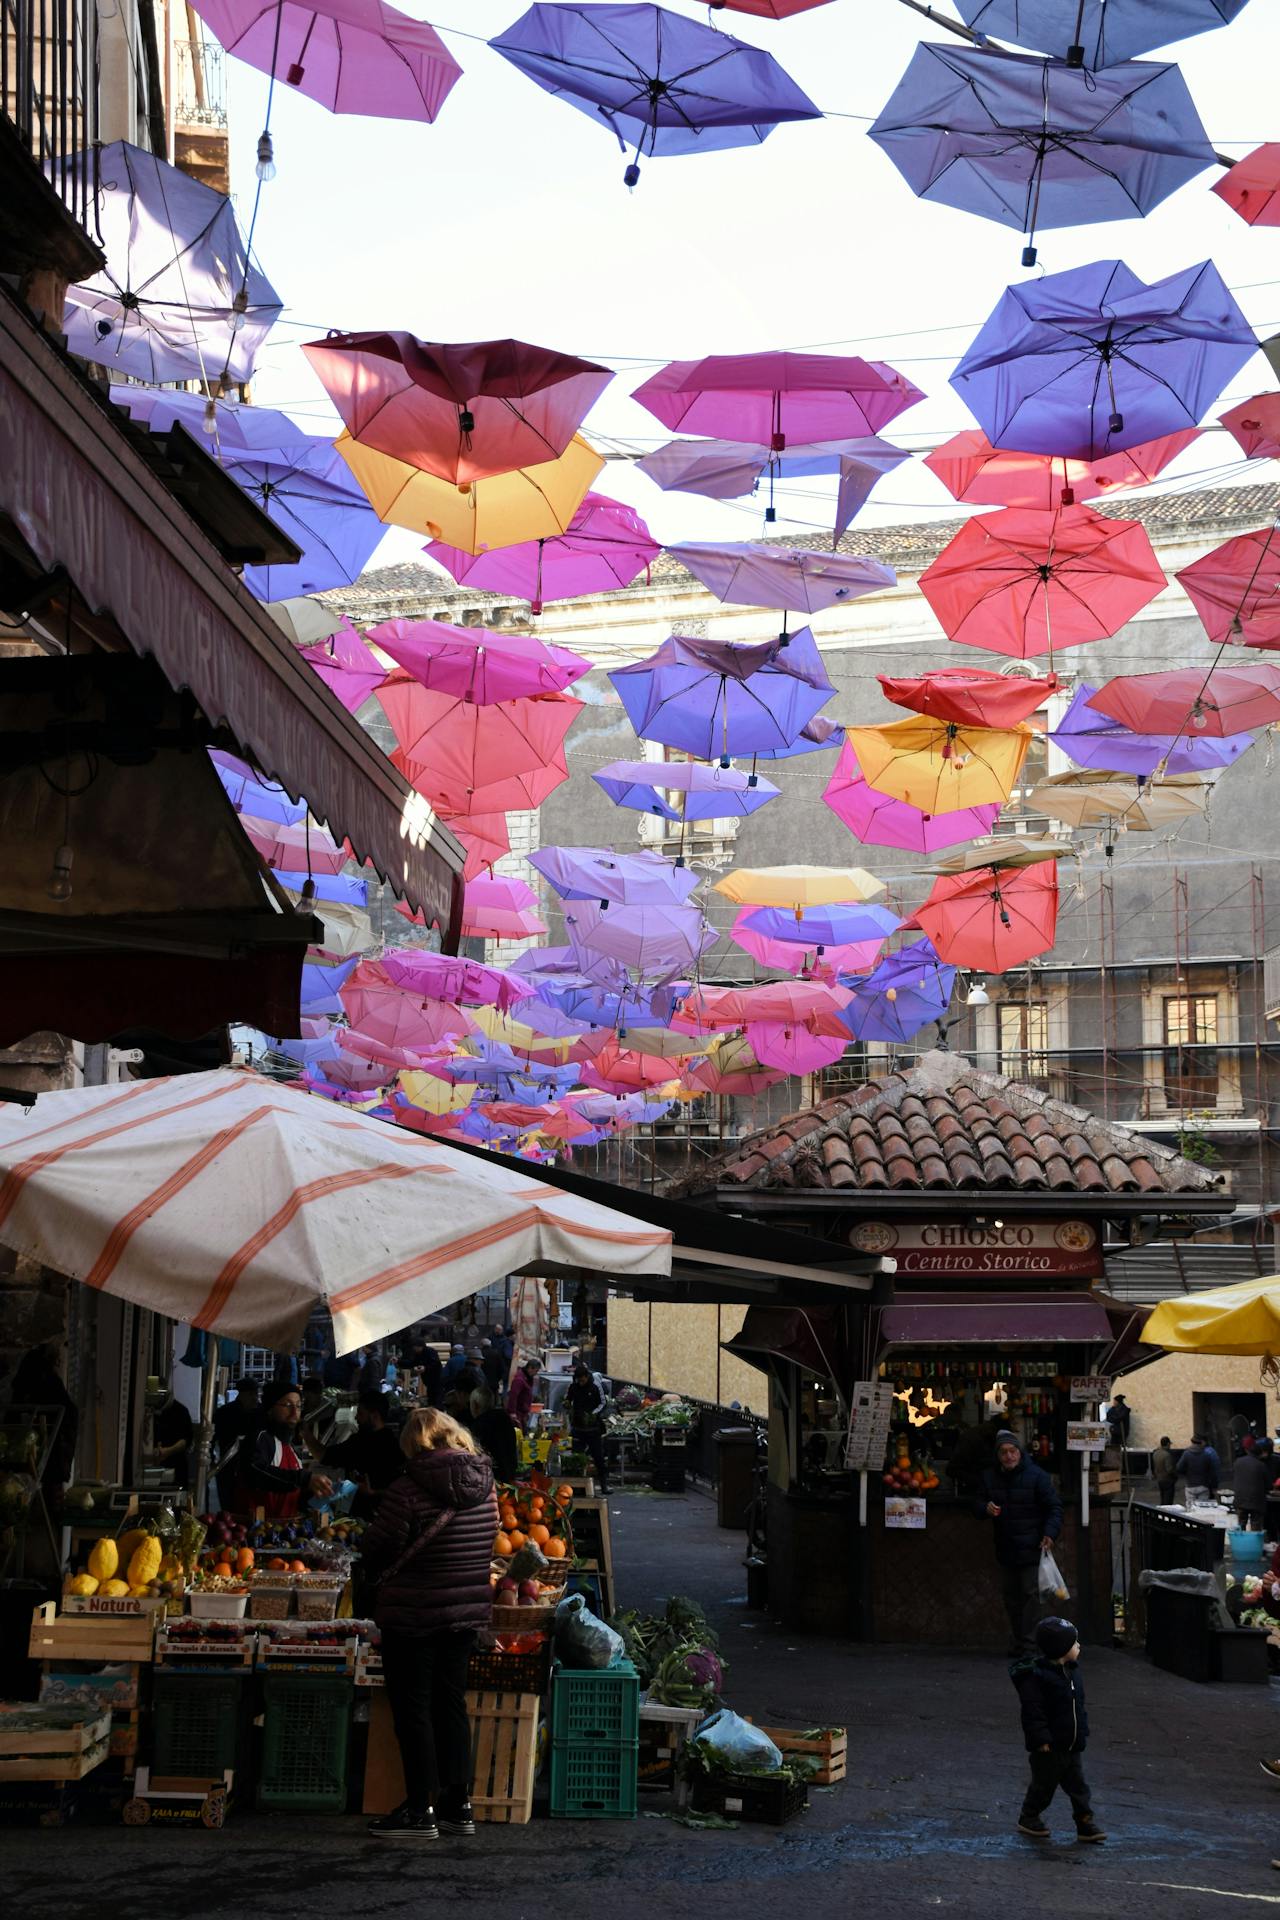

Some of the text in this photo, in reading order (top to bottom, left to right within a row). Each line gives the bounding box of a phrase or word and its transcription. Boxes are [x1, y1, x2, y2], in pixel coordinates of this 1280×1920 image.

[921, 1226, 1034, 1246] CHIOSCO
[904, 1252, 973, 1272] Centro
[979, 1251, 1051, 1272] Storico
